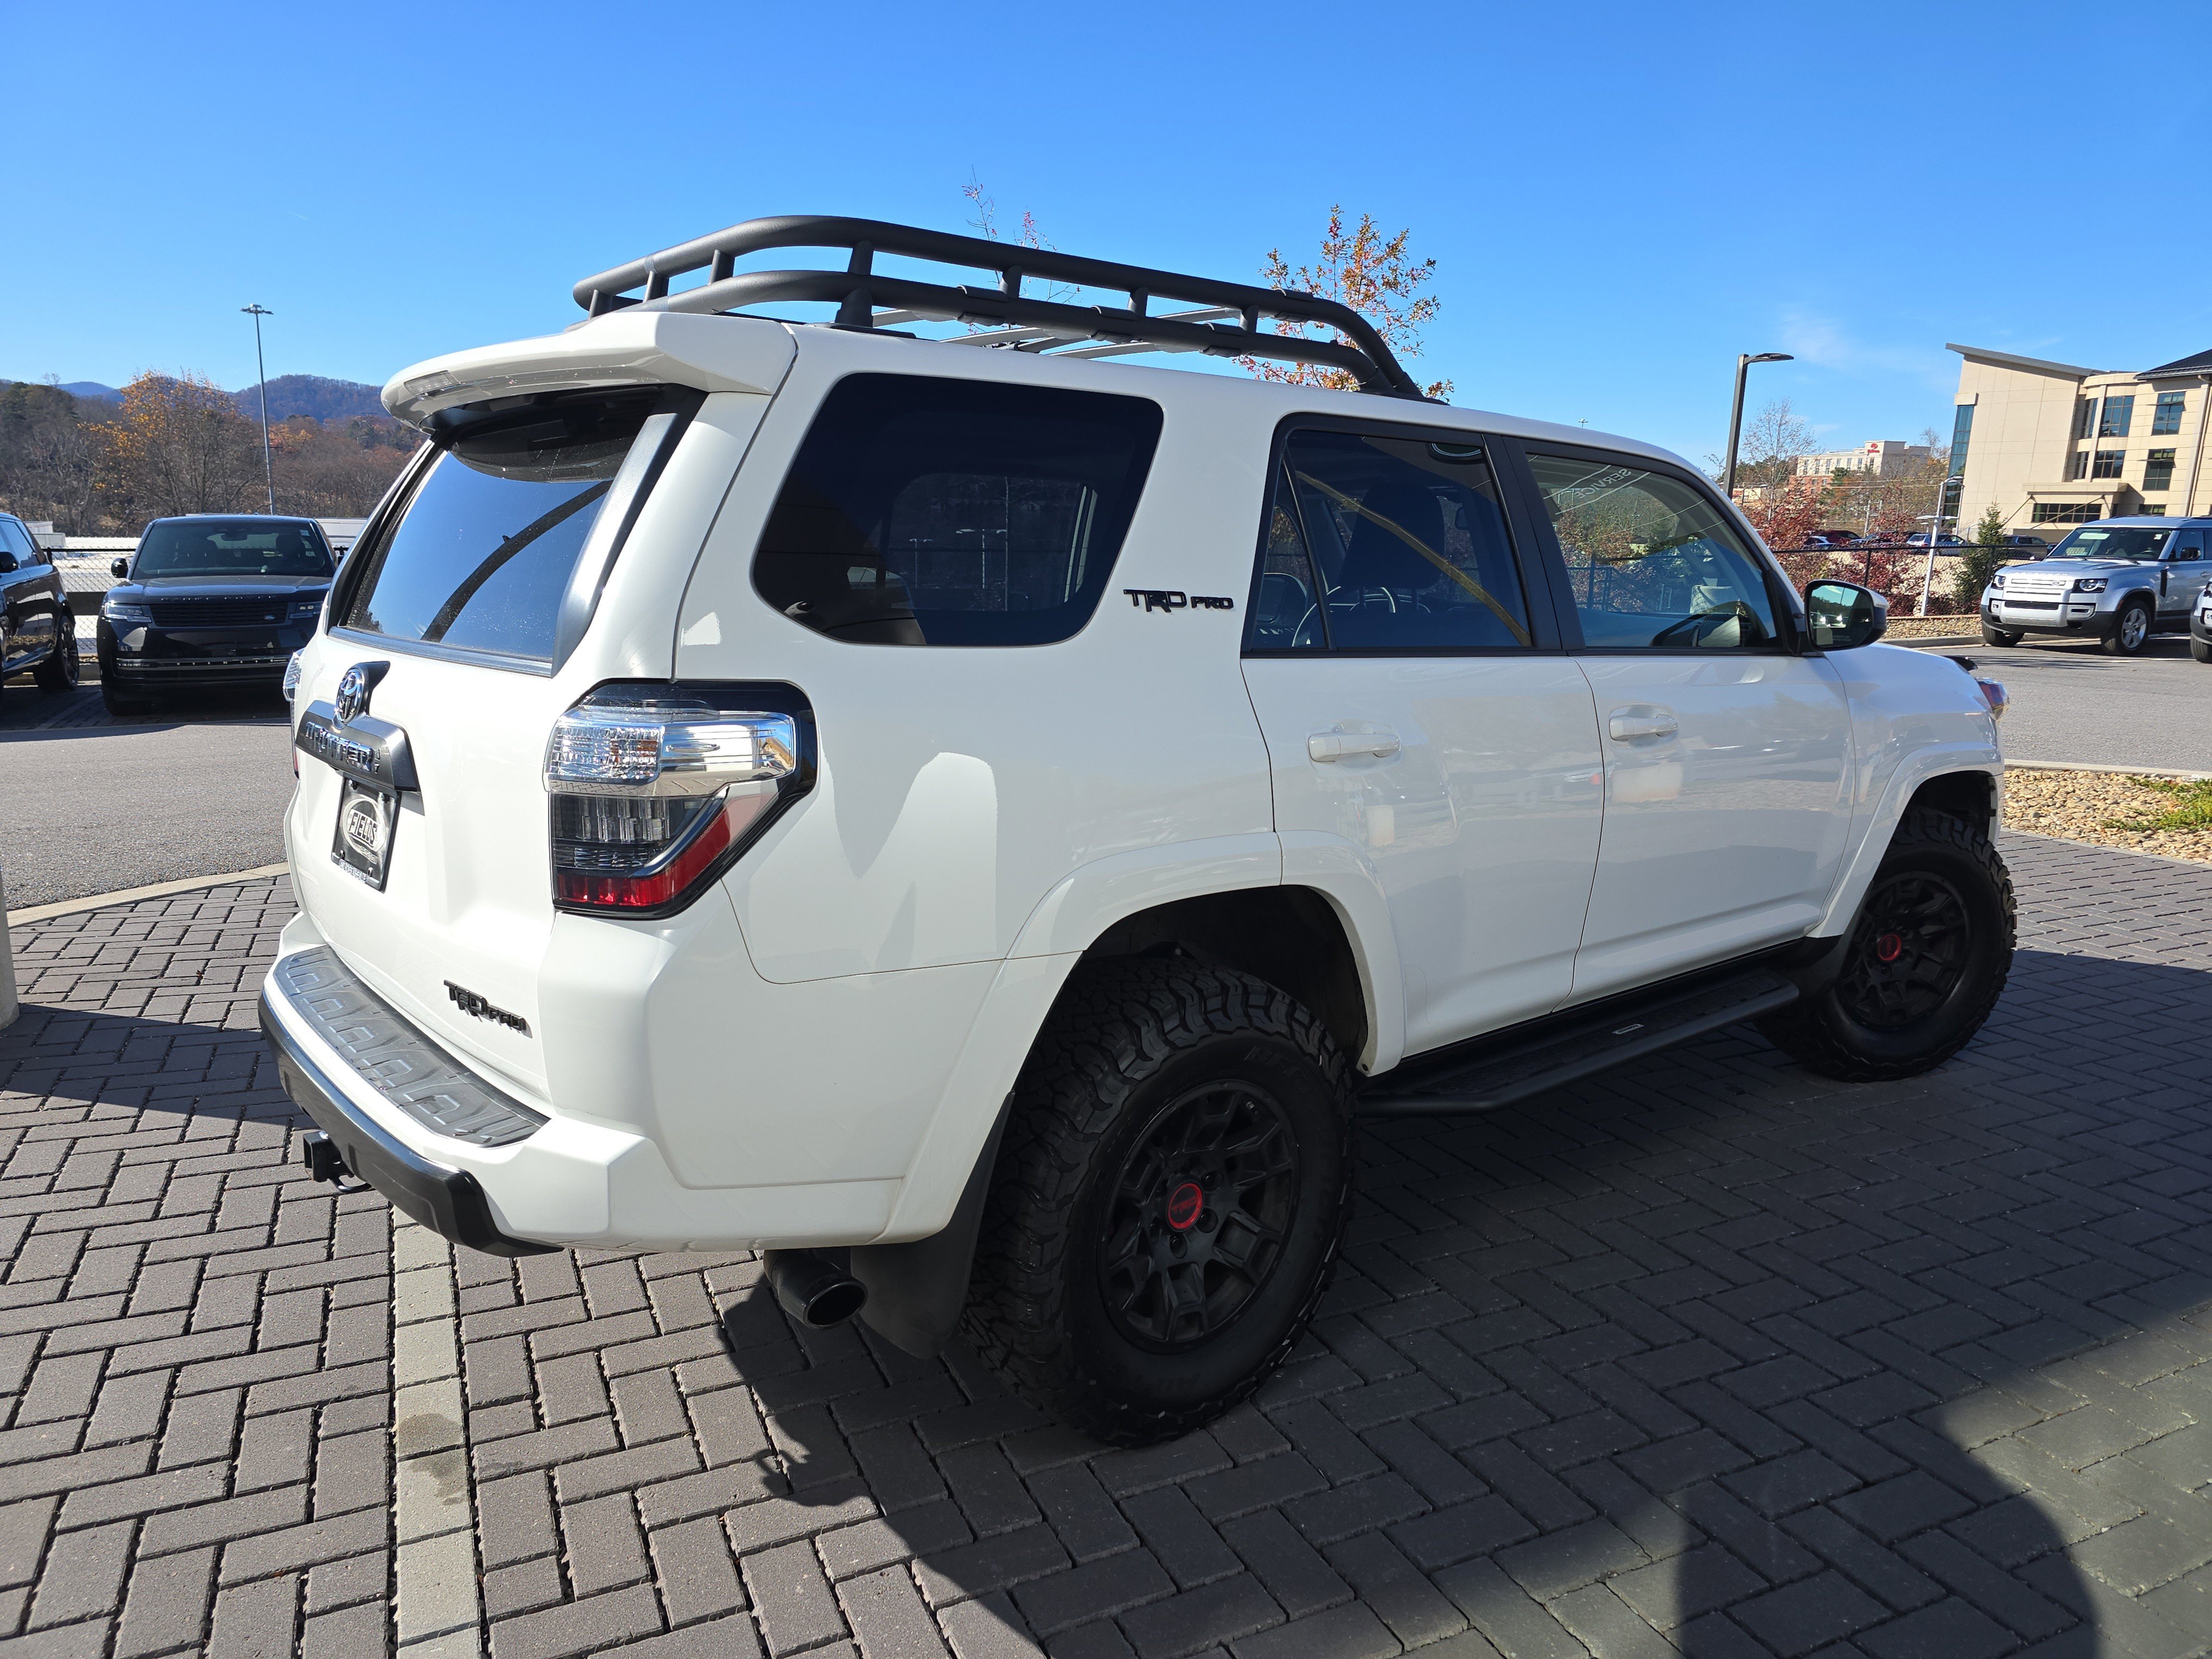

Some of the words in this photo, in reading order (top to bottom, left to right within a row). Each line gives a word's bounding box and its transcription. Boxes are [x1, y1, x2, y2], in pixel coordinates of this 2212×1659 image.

[1123, 589, 1187, 613] TRD
[1190, 596, 1234, 609] PRO
[349, 812, 377, 845] FIELDS
[443, 979, 488, 1017] TRD
[487, 1004, 527, 1031] PRO
